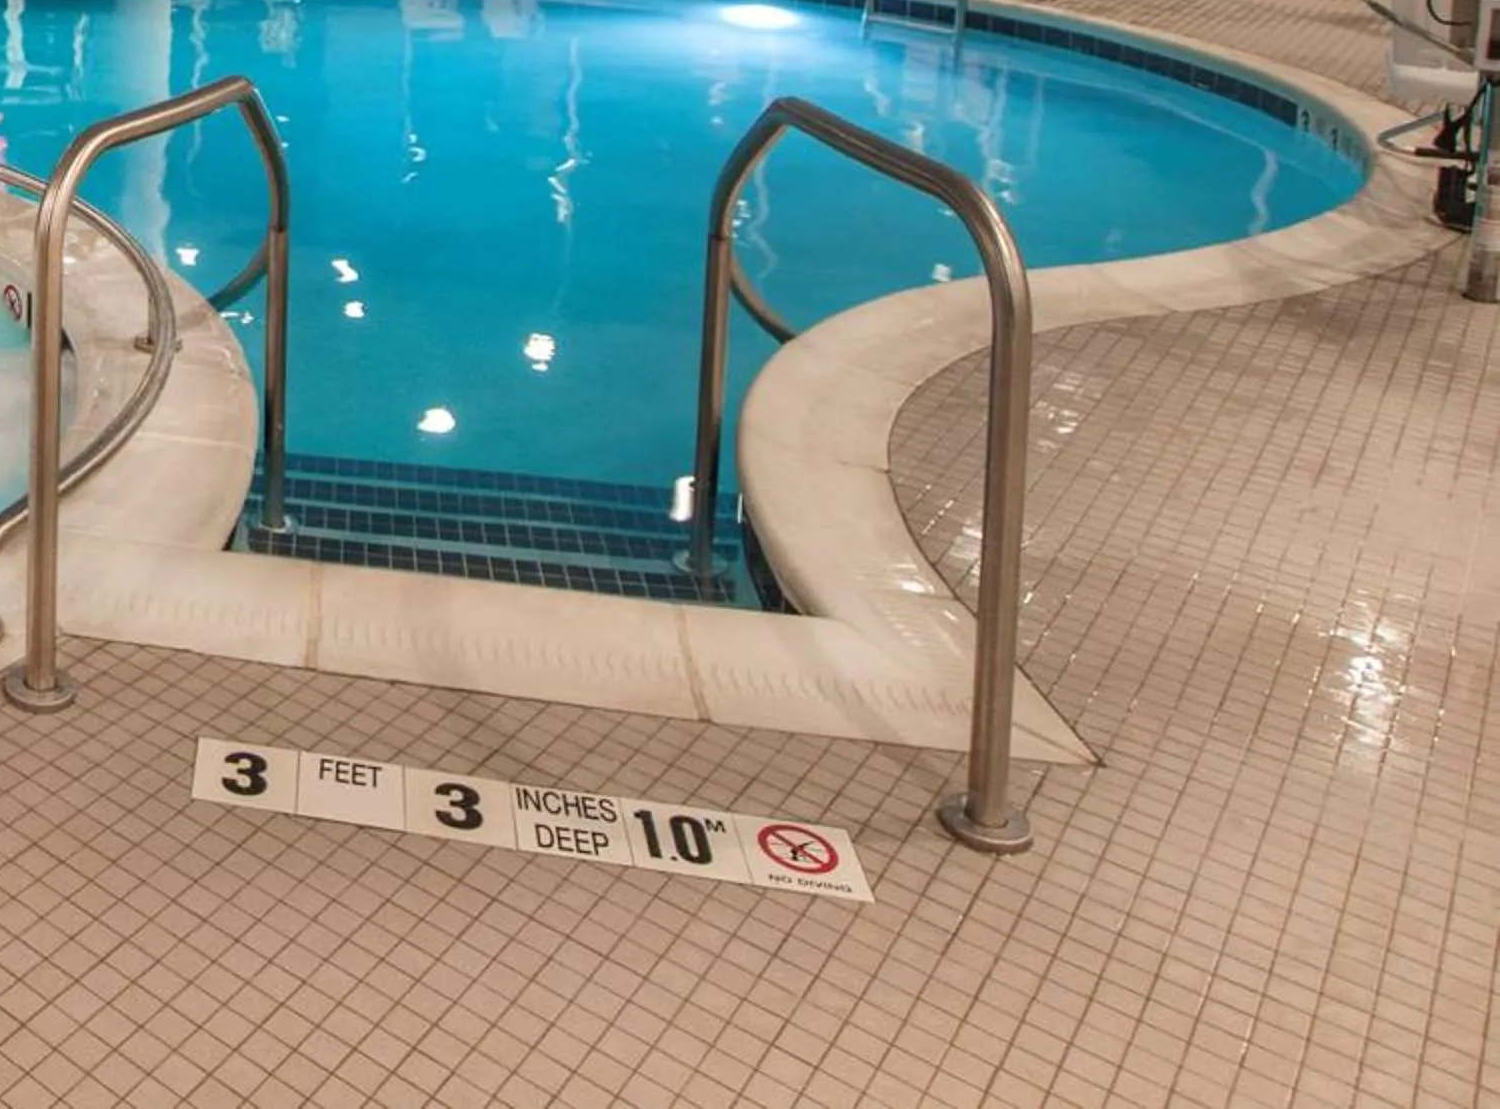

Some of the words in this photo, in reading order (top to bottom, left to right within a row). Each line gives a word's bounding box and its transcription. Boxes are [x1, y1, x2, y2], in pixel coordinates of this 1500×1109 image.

[221, 751, 268, 796] 3
[319, 758, 383, 788] FEET
[434, 782, 484, 831] 3
[515, 787, 618, 824] INCHES
[534, 823, 610, 856] DEEP
